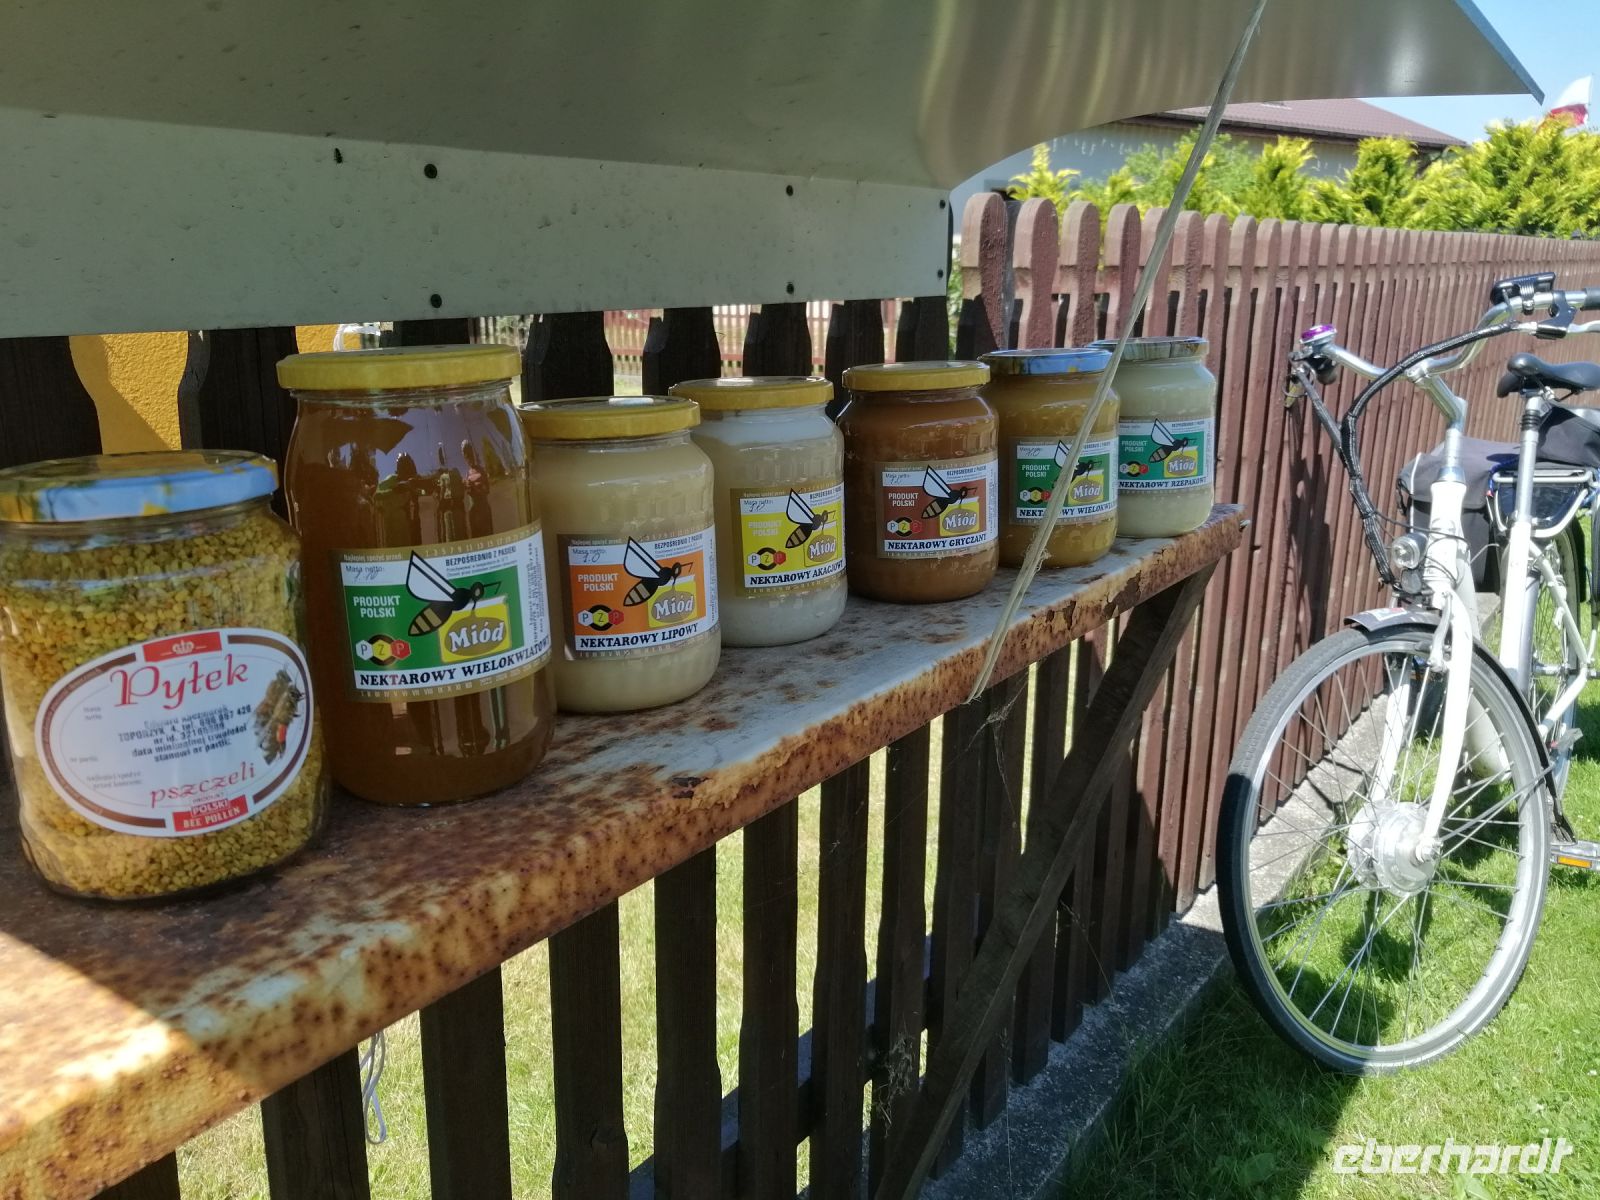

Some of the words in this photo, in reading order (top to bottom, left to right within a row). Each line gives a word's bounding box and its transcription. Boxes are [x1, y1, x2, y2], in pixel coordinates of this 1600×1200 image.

[1168, 459, 1195, 473] Miód
[888, 492, 919, 500] PRODUKT
[1073, 483, 1101, 500] Miód
[892, 499, 915, 507] POLSKI
[1019, 508, 1075, 517] NEKTWY
[945, 513, 977, 530] Miód
[809, 538, 836, 559] Miód
[888, 540, 949, 550] NEKTAROWY
[949, 533, 987, 547] GRYCZANY
[445, 551, 493, 567] BEZPOŚREDNIO
[498, 545, 517, 557] PASIEKI
[577, 572, 619, 583] PRODUKT
[750, 571, 811, 585] NEKTAROWY
[812, 559, 844, 578] AKACJOWY
[583, 582, 615, 592] POLSKI
[353, 595, 401, 607] PRODUKT
[654, 594, 694, 620] Miód
[360, 607, 396, 618] POLSKI
[449, 621, 505, 653] Miód
[580, 633, 659, 648] NEKTAROWY
[661, 622, 698, 641] LIPOWY
[360, 668, 456, 686] NEKTAROWY
[462, 635, 549, 677] WIELOKWIATOWY
[110, 653, 249, 710] Pyłek
[132, 747, 153, 758] data
[150, 761, 255, 808] pszczeli
[192, 799, 228, 817] POLSKI
[183, 818, 201, 829] BEE
[205, 807, 241, 824] POLLEN
